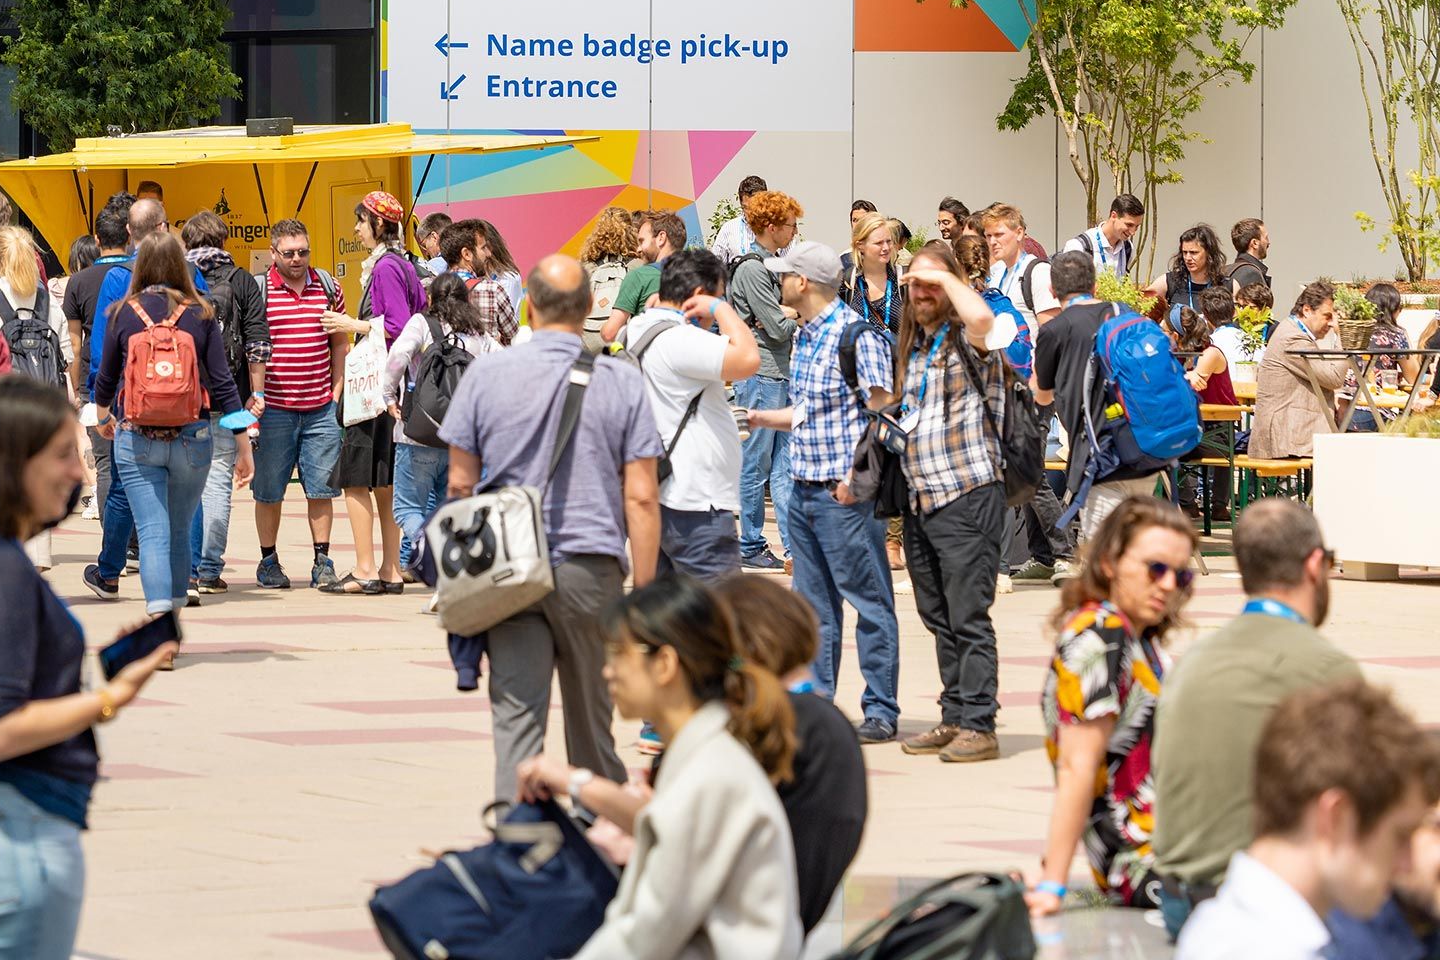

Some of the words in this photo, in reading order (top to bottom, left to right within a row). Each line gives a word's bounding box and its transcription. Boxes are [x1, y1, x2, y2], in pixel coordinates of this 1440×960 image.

[487, 33, 574, 57] Name
[583, 33, 671, 65] badge
[680, 33, 789, 65] pick-up
[487, 75, 618, 98] Entrance
